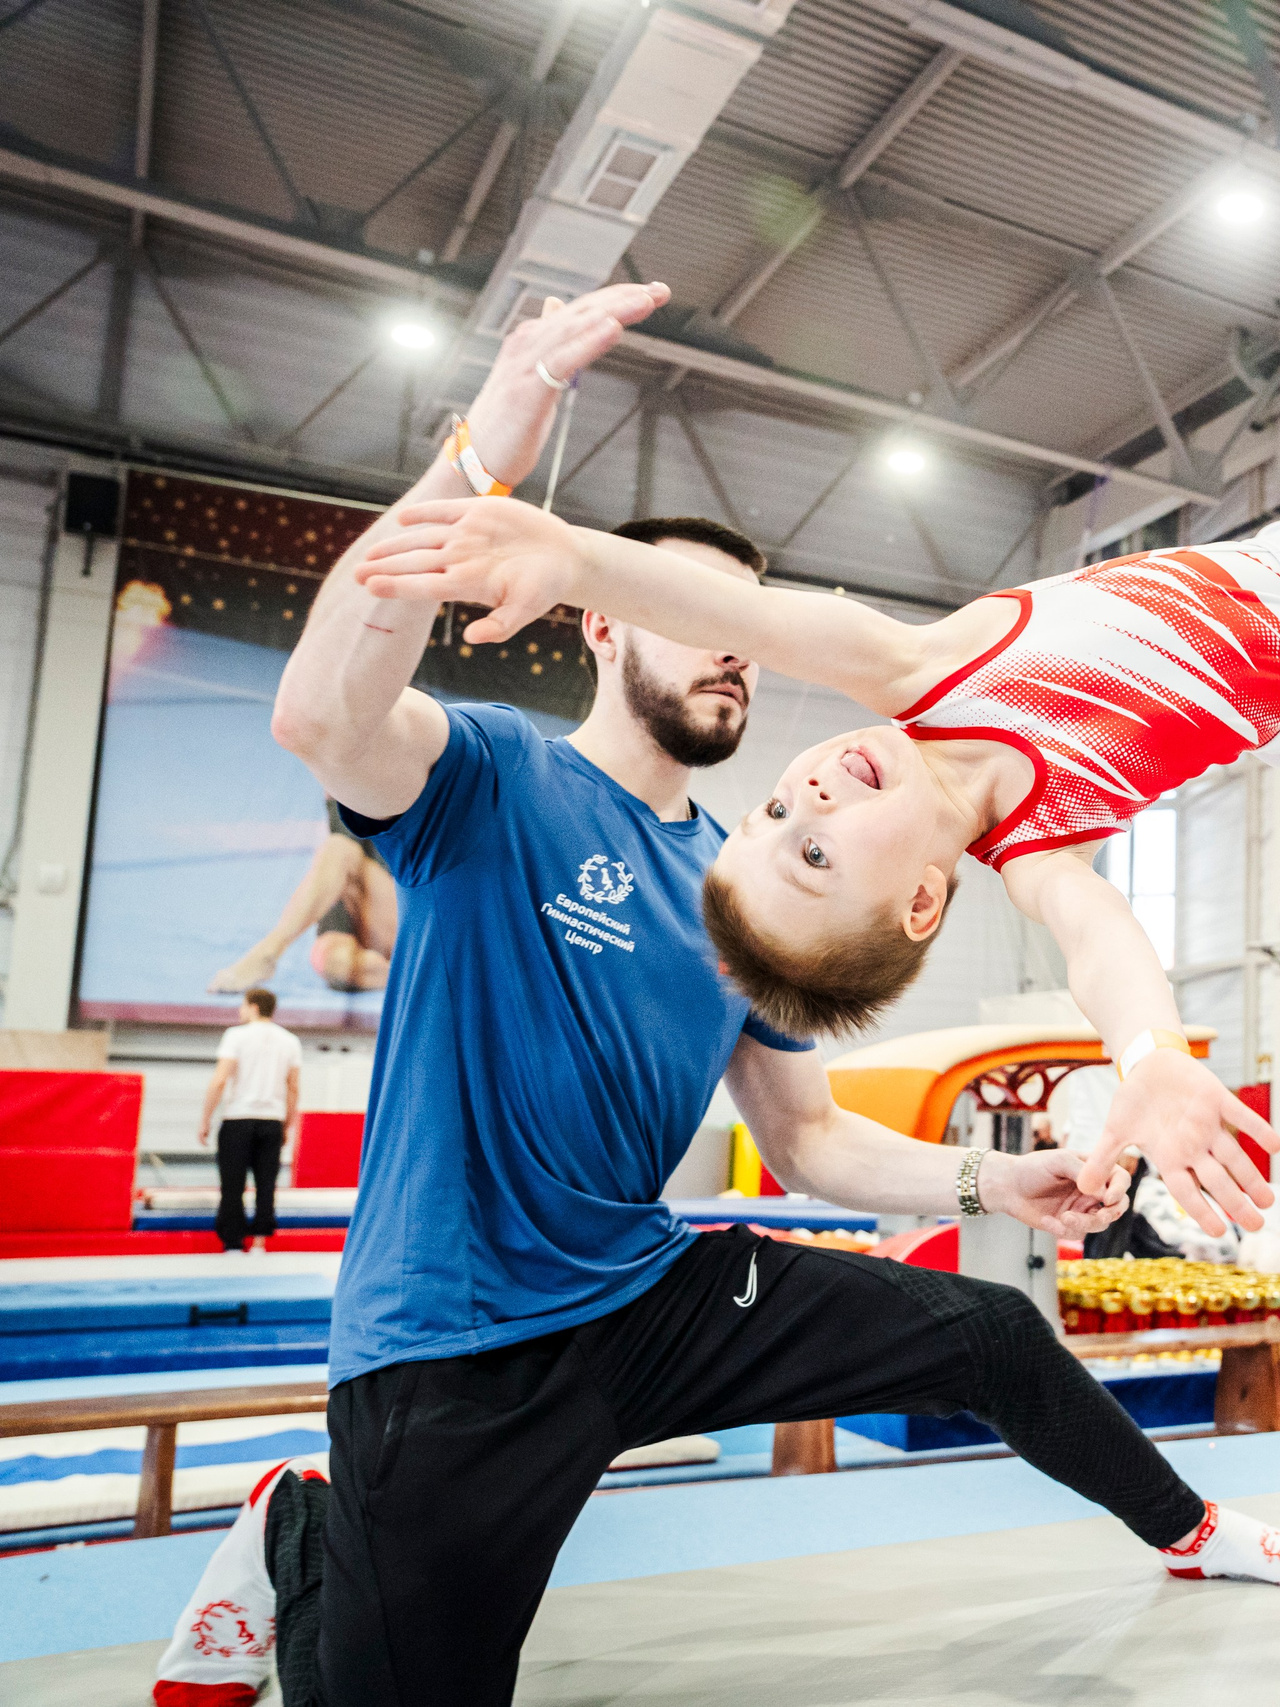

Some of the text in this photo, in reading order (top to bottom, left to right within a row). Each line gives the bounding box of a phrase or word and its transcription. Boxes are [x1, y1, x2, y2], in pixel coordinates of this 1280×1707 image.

[540, 902, 635, 952] Гимнастический
[555, 893, 631, 935] Европейский
[564, 929, 603, 955] Центр
